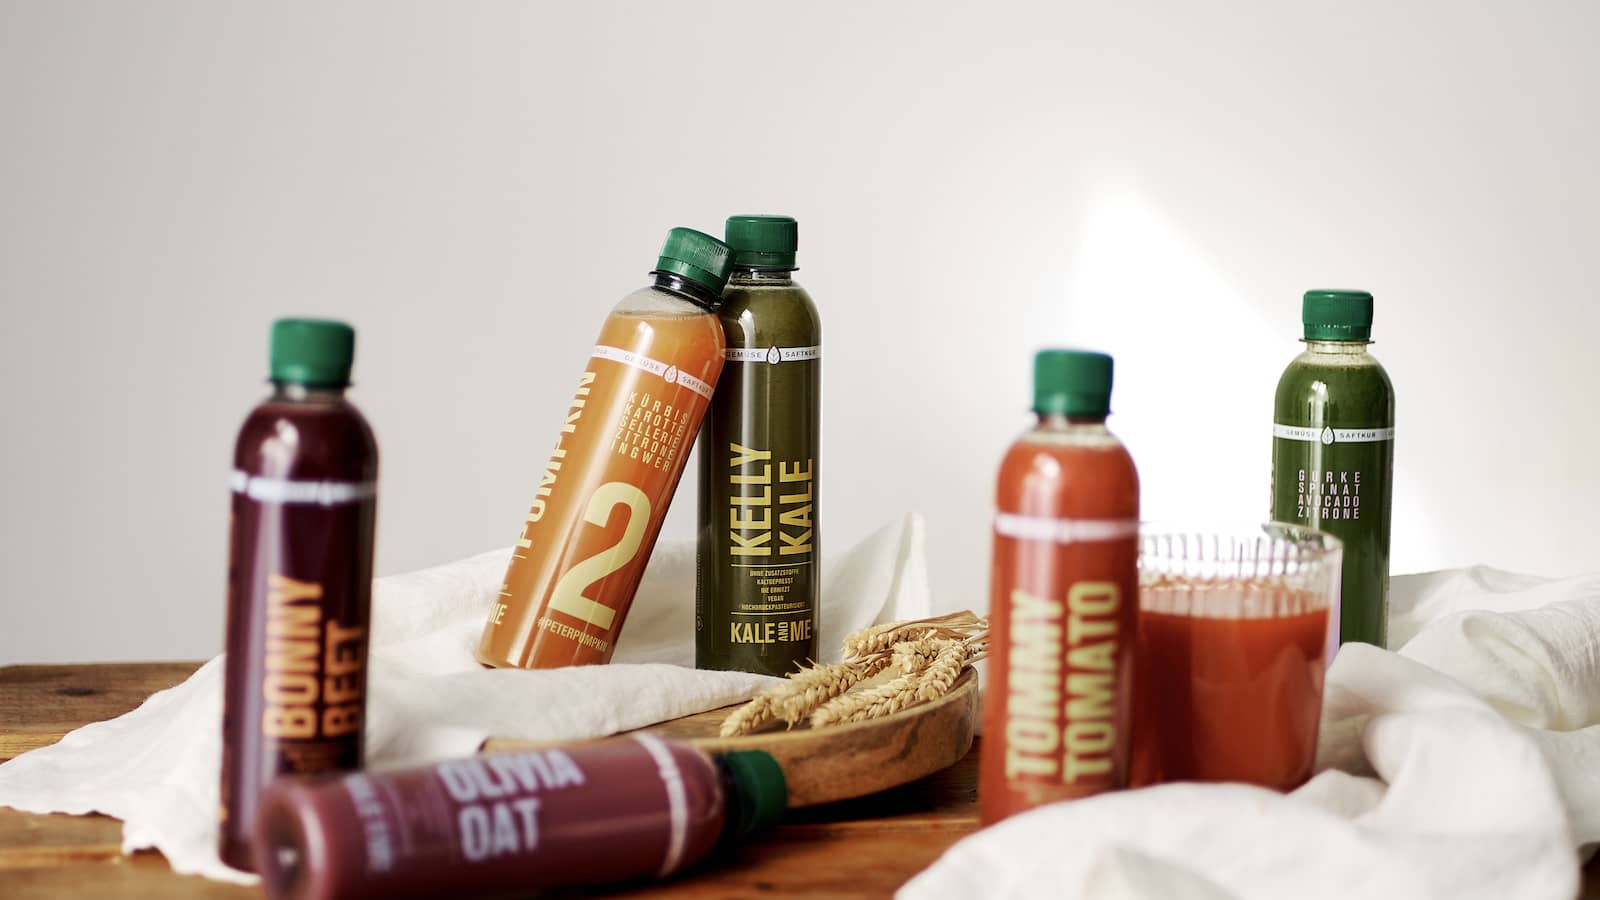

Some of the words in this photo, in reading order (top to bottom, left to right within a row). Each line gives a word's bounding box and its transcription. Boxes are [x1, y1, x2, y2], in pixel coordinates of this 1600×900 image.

[619, 414, 680, 449] SELLERIE
[623, 402, 684, 437] KAROTTE
[1339, 431, 1376, 439] SAFTKUR
[610, 439, 671, 473] INGWER
[614, 427, 675, 460] ZITRONE
[1298, 469, 1361, 483] GURKE
[1298, 482, 1361, 496] SPINAT
[730, 443, 771, 556] KELLY
[779, 458, 813, 556] KALE
[1297, 494, 1360, 508] AVOCADO
[1297, 505, 1360, 520] ZITRONE
[548, 481, 651, 631] 2
[730, 621, 776, 644] KALE
[777, 621, 789, 642] AND
[790, 619, 812, 642] ME
[262, 574, 323, 738] BONNY
[322, 619, 364, 738] BEET
[1005, 590, 1063, 780] TOMMY
[1063, 581, 1119, 784] TOMATO
[436, 749, 585, 802] OLIVIA
[458, 797, 541, 862] OAT
